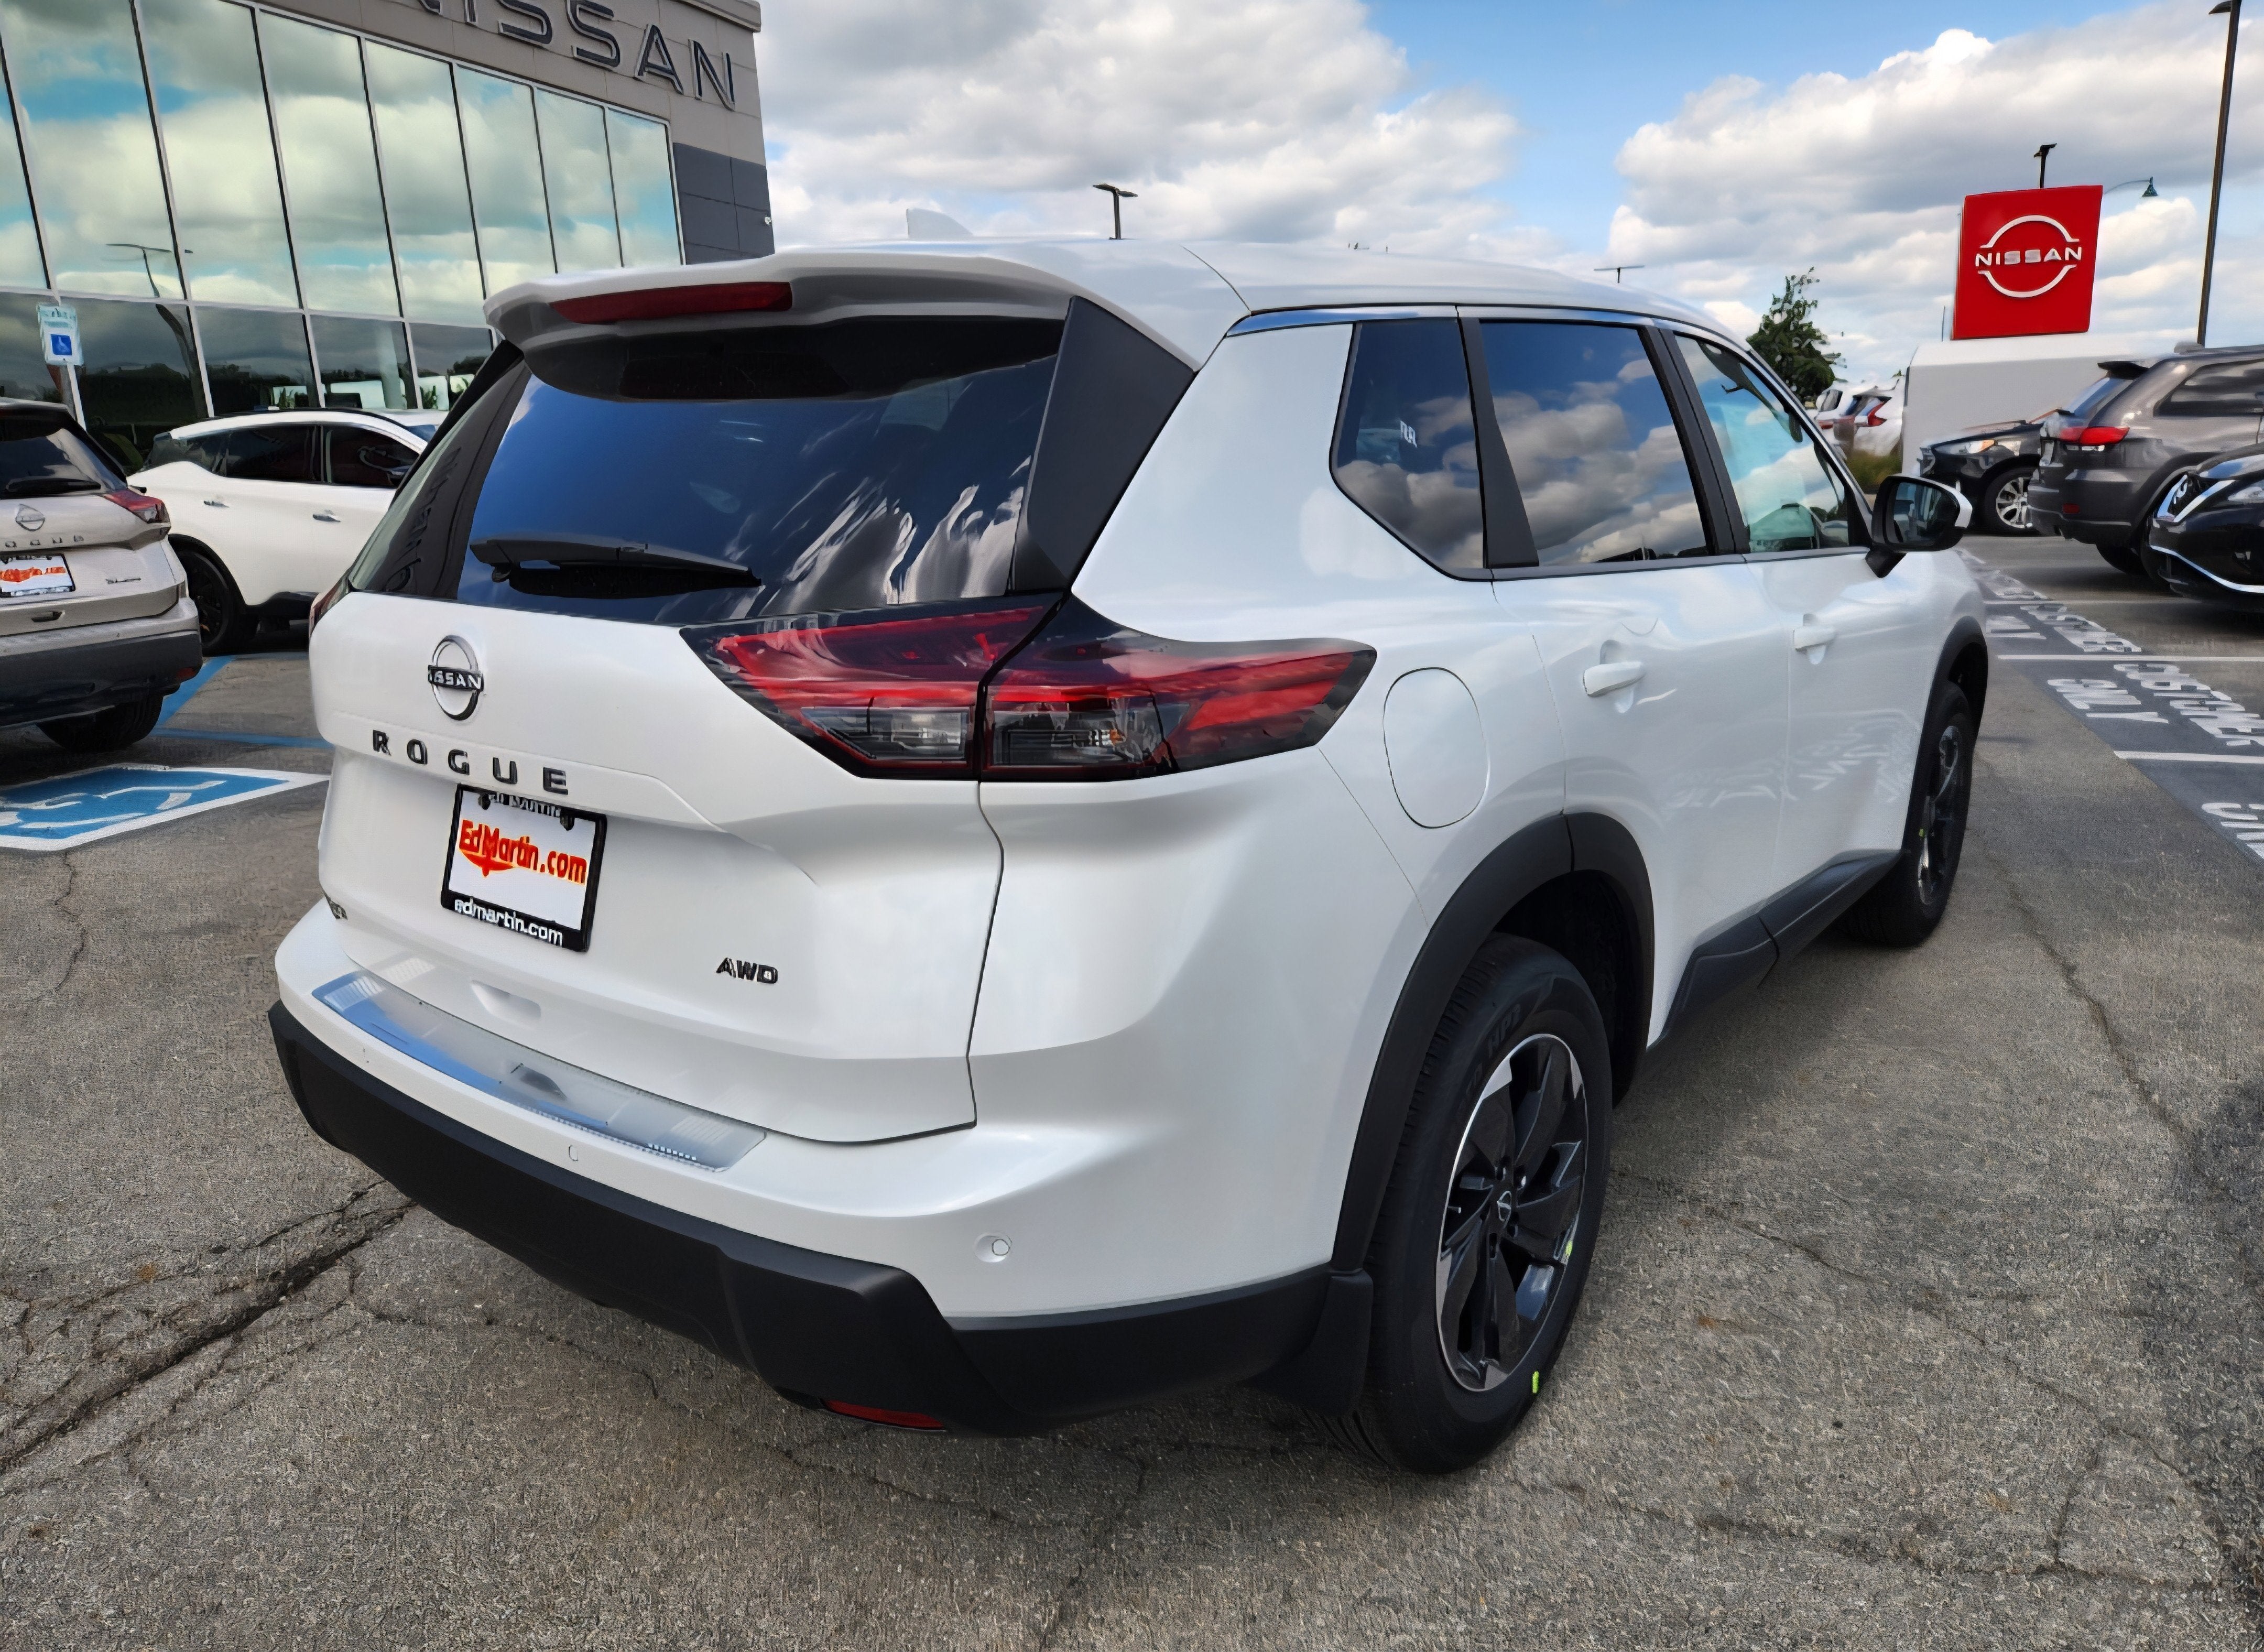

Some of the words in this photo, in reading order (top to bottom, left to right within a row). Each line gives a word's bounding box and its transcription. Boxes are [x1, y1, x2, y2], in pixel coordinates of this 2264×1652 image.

[416, 0, 736, 112] ISSAN
[1975, 246, 2082, 267] NISSAN
[372, 729, 569, 796] ROGUE
[459, 819, 587, 885] EdMartin.com
[454, 898, 563, 947] edmartin.com
[716, 957, 778, 984] AWD
